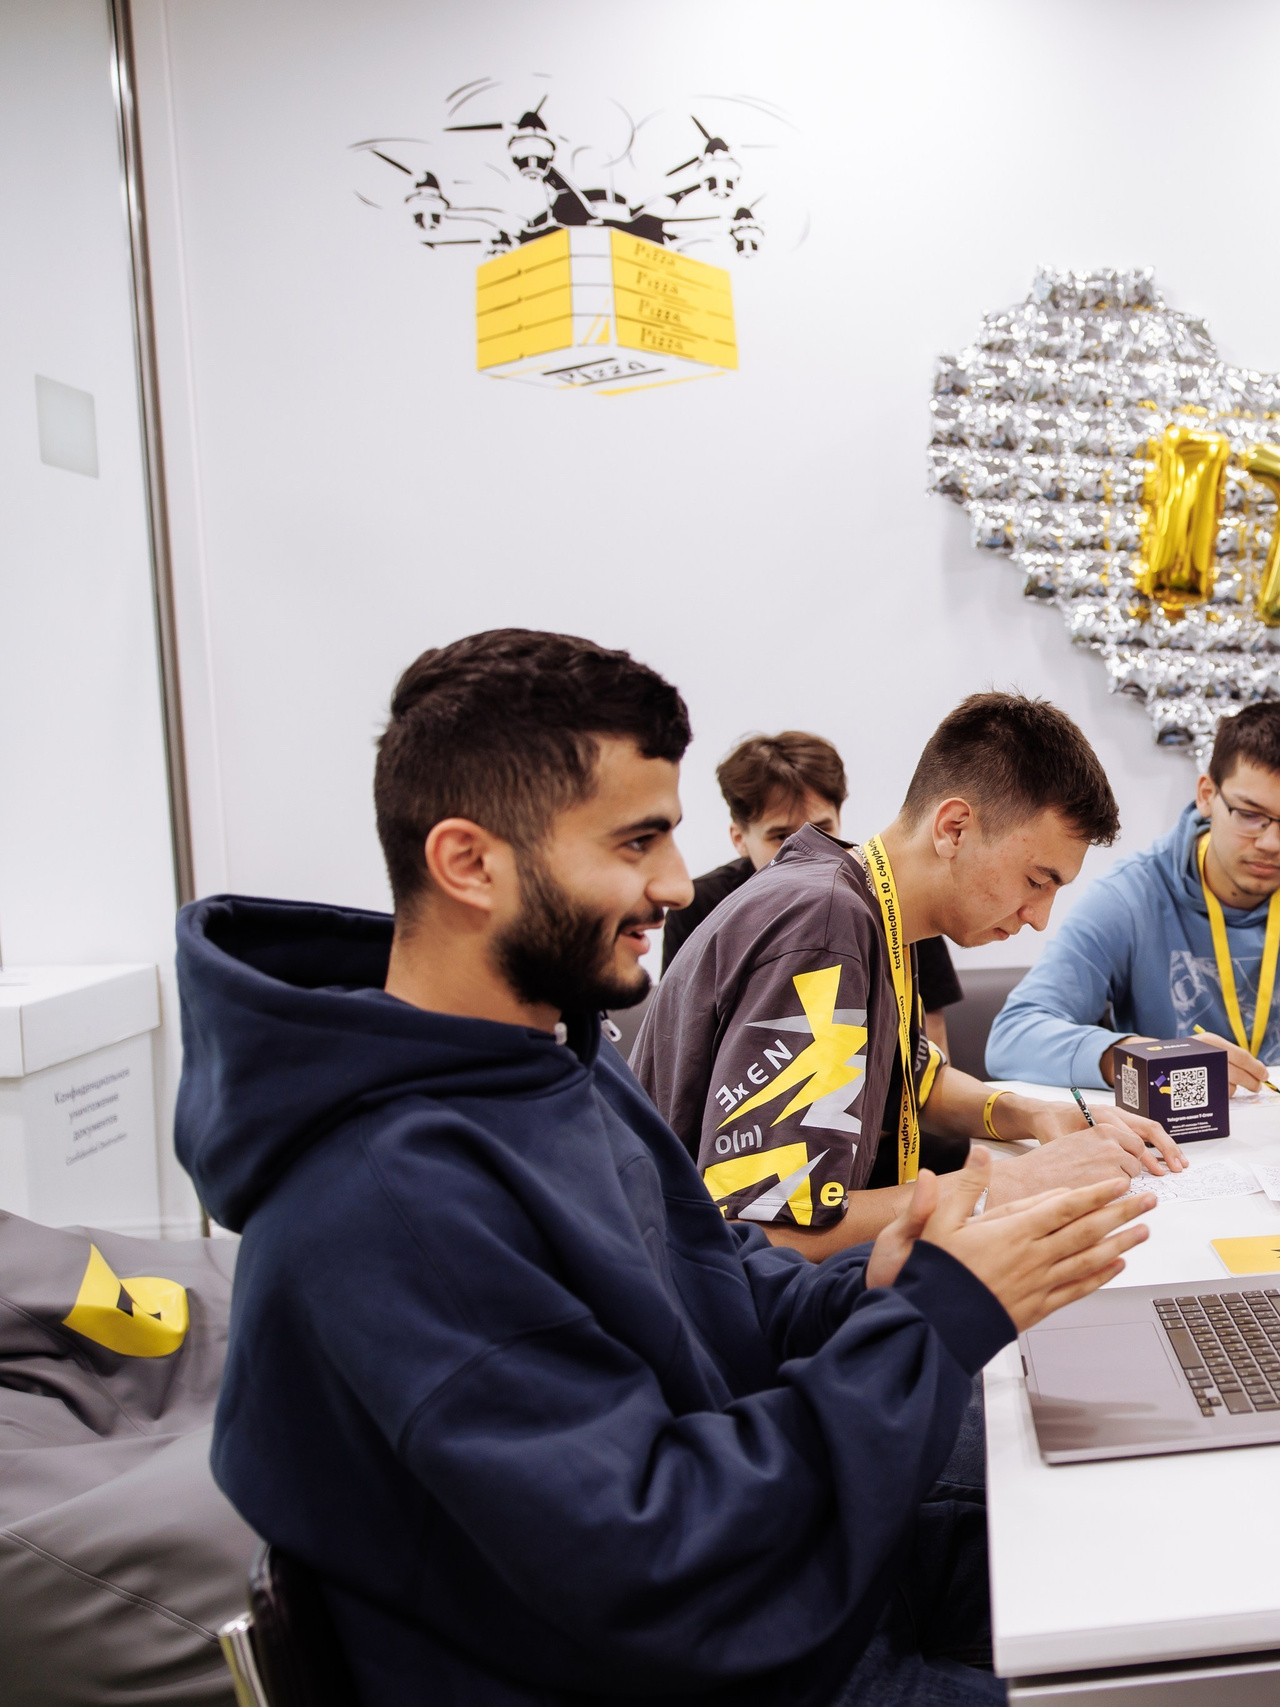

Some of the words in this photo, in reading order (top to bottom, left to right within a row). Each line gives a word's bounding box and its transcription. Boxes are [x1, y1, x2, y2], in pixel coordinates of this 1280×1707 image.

[635, 241, 676, 268] Pizza
[636, 269, 679, 295] Pizza
[638, 297, 682, 323] Pizza
[640, 326, 684, 351] Pizza
